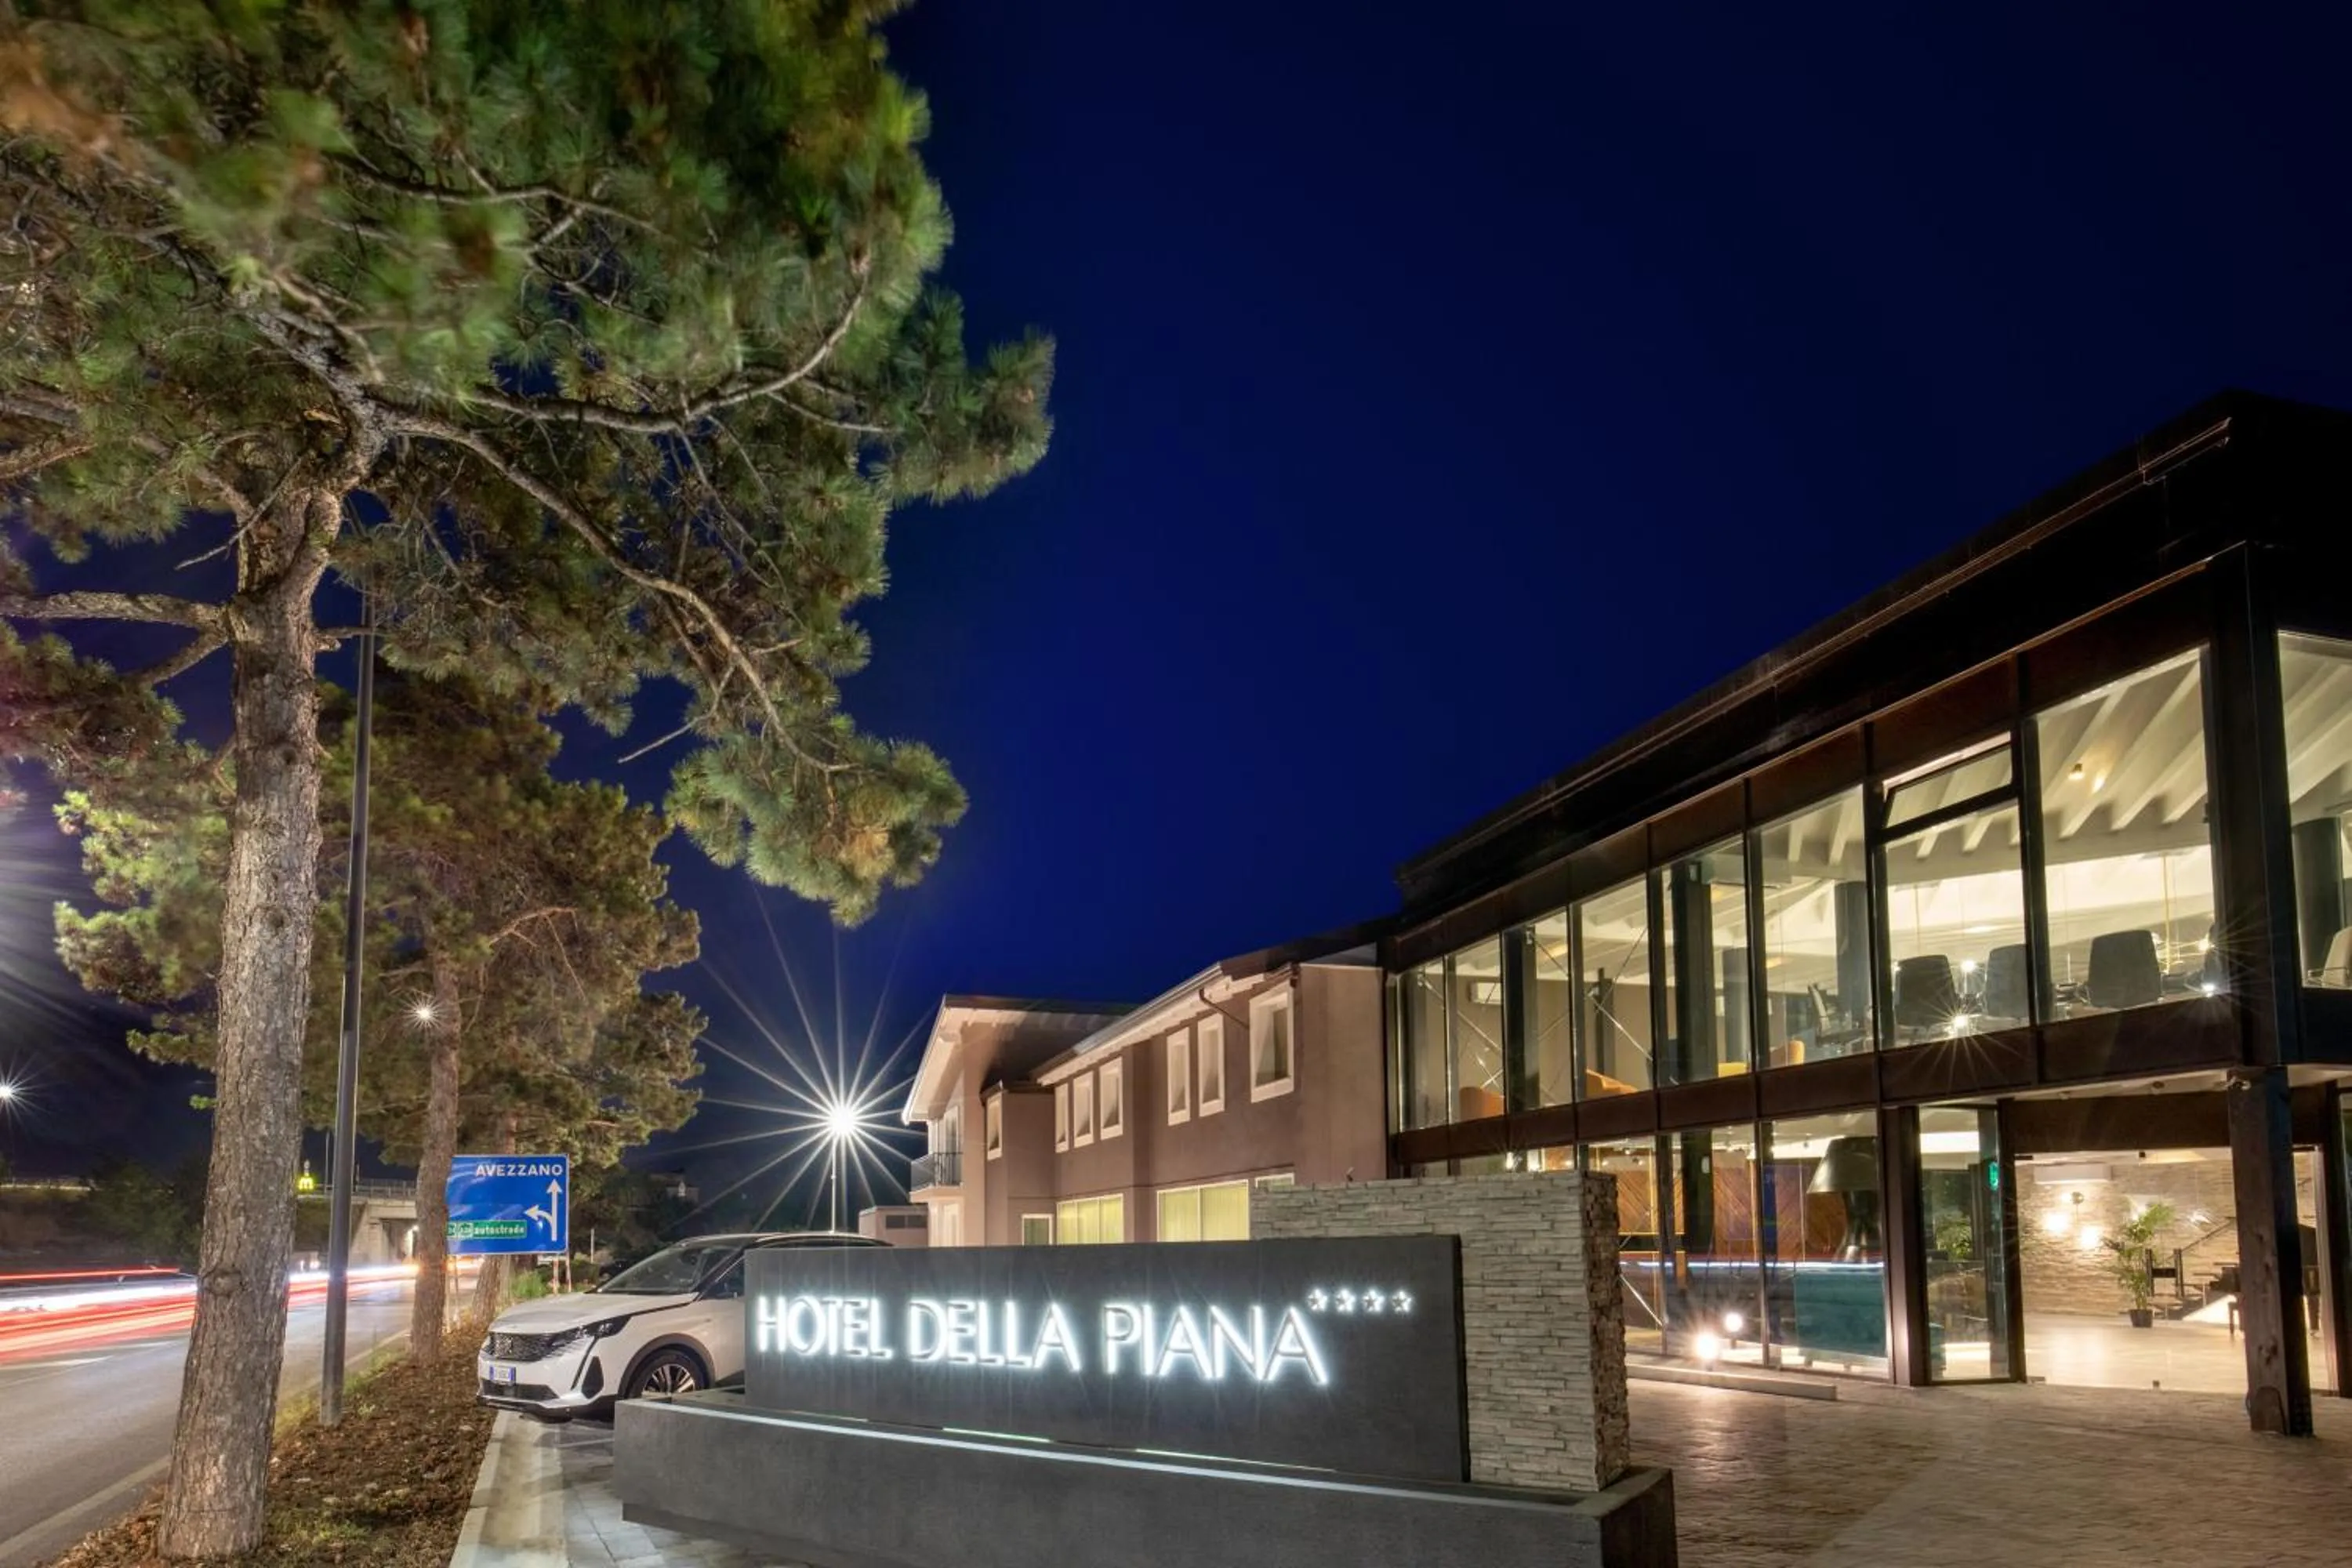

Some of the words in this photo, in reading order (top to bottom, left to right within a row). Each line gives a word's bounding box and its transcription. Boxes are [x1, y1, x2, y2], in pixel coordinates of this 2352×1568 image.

[475, 1164, 563, 1177] AVEZZANO
[757, 1296, 893, 1359] HOTEL
[907, 1299, 1082, 1372] DELLA
[1102, 1303, 1331, 1385] PIANA
